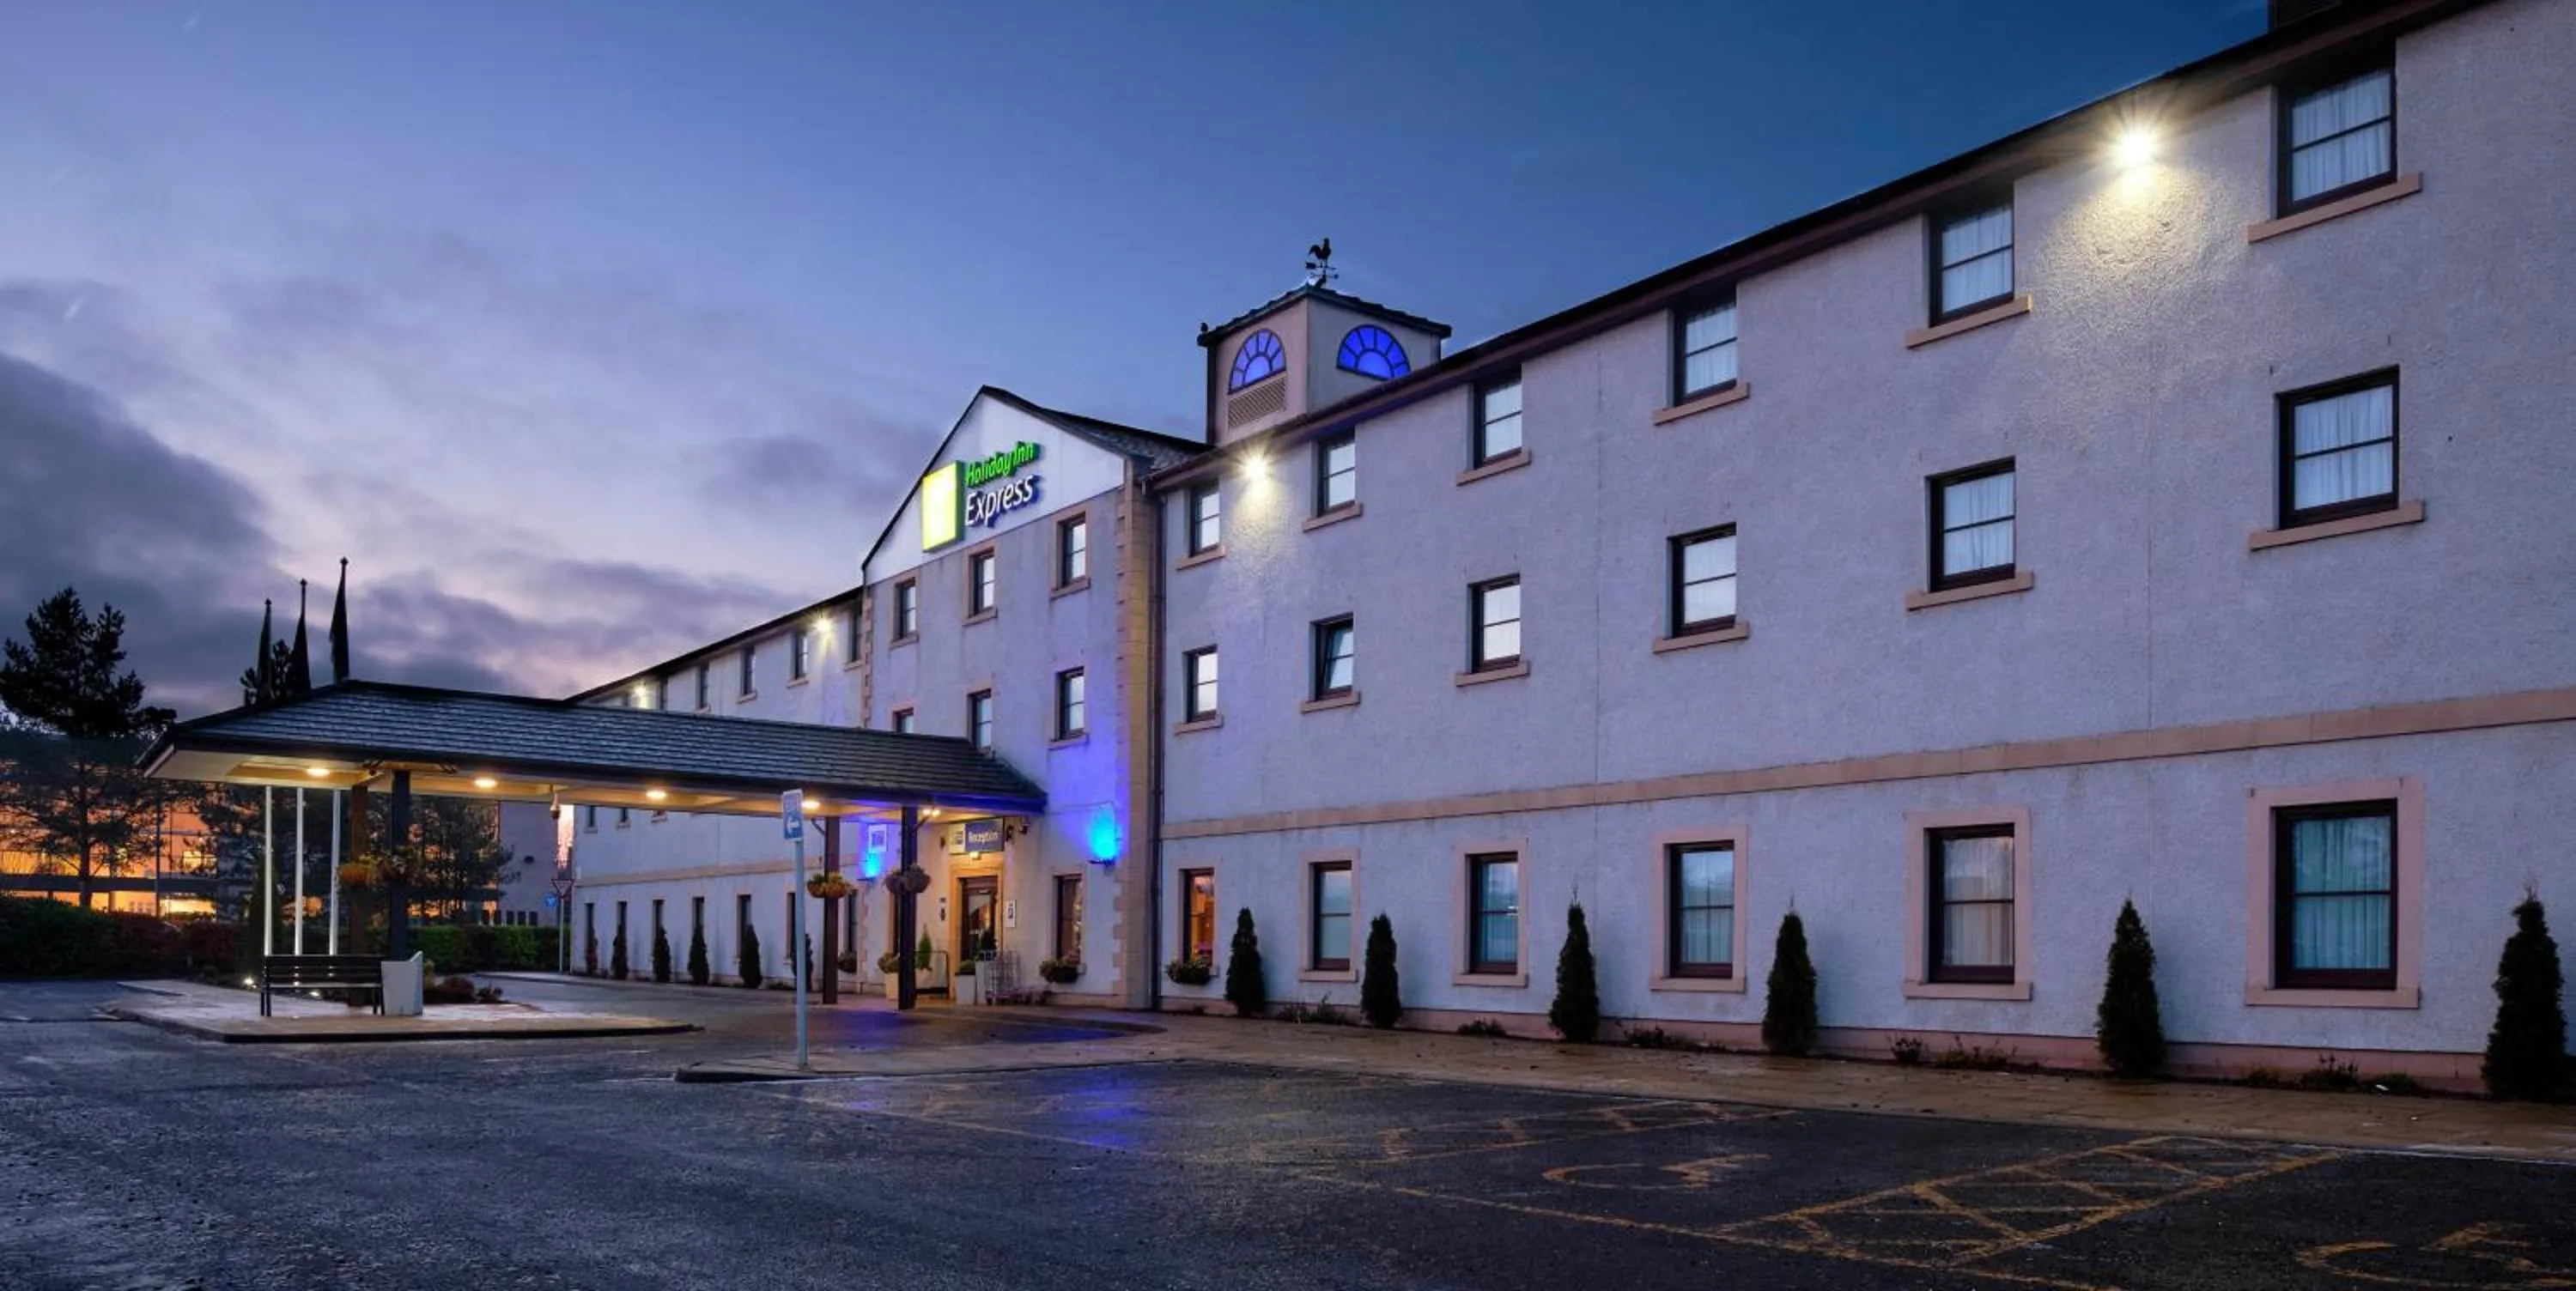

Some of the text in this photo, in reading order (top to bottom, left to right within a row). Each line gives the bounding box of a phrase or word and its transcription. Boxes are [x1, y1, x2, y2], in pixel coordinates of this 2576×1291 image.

[965, 441, 1036, 488] Holiday Inn
[964, 475, 1036, 526] Express
[968, 830, 999, 845] Reception
